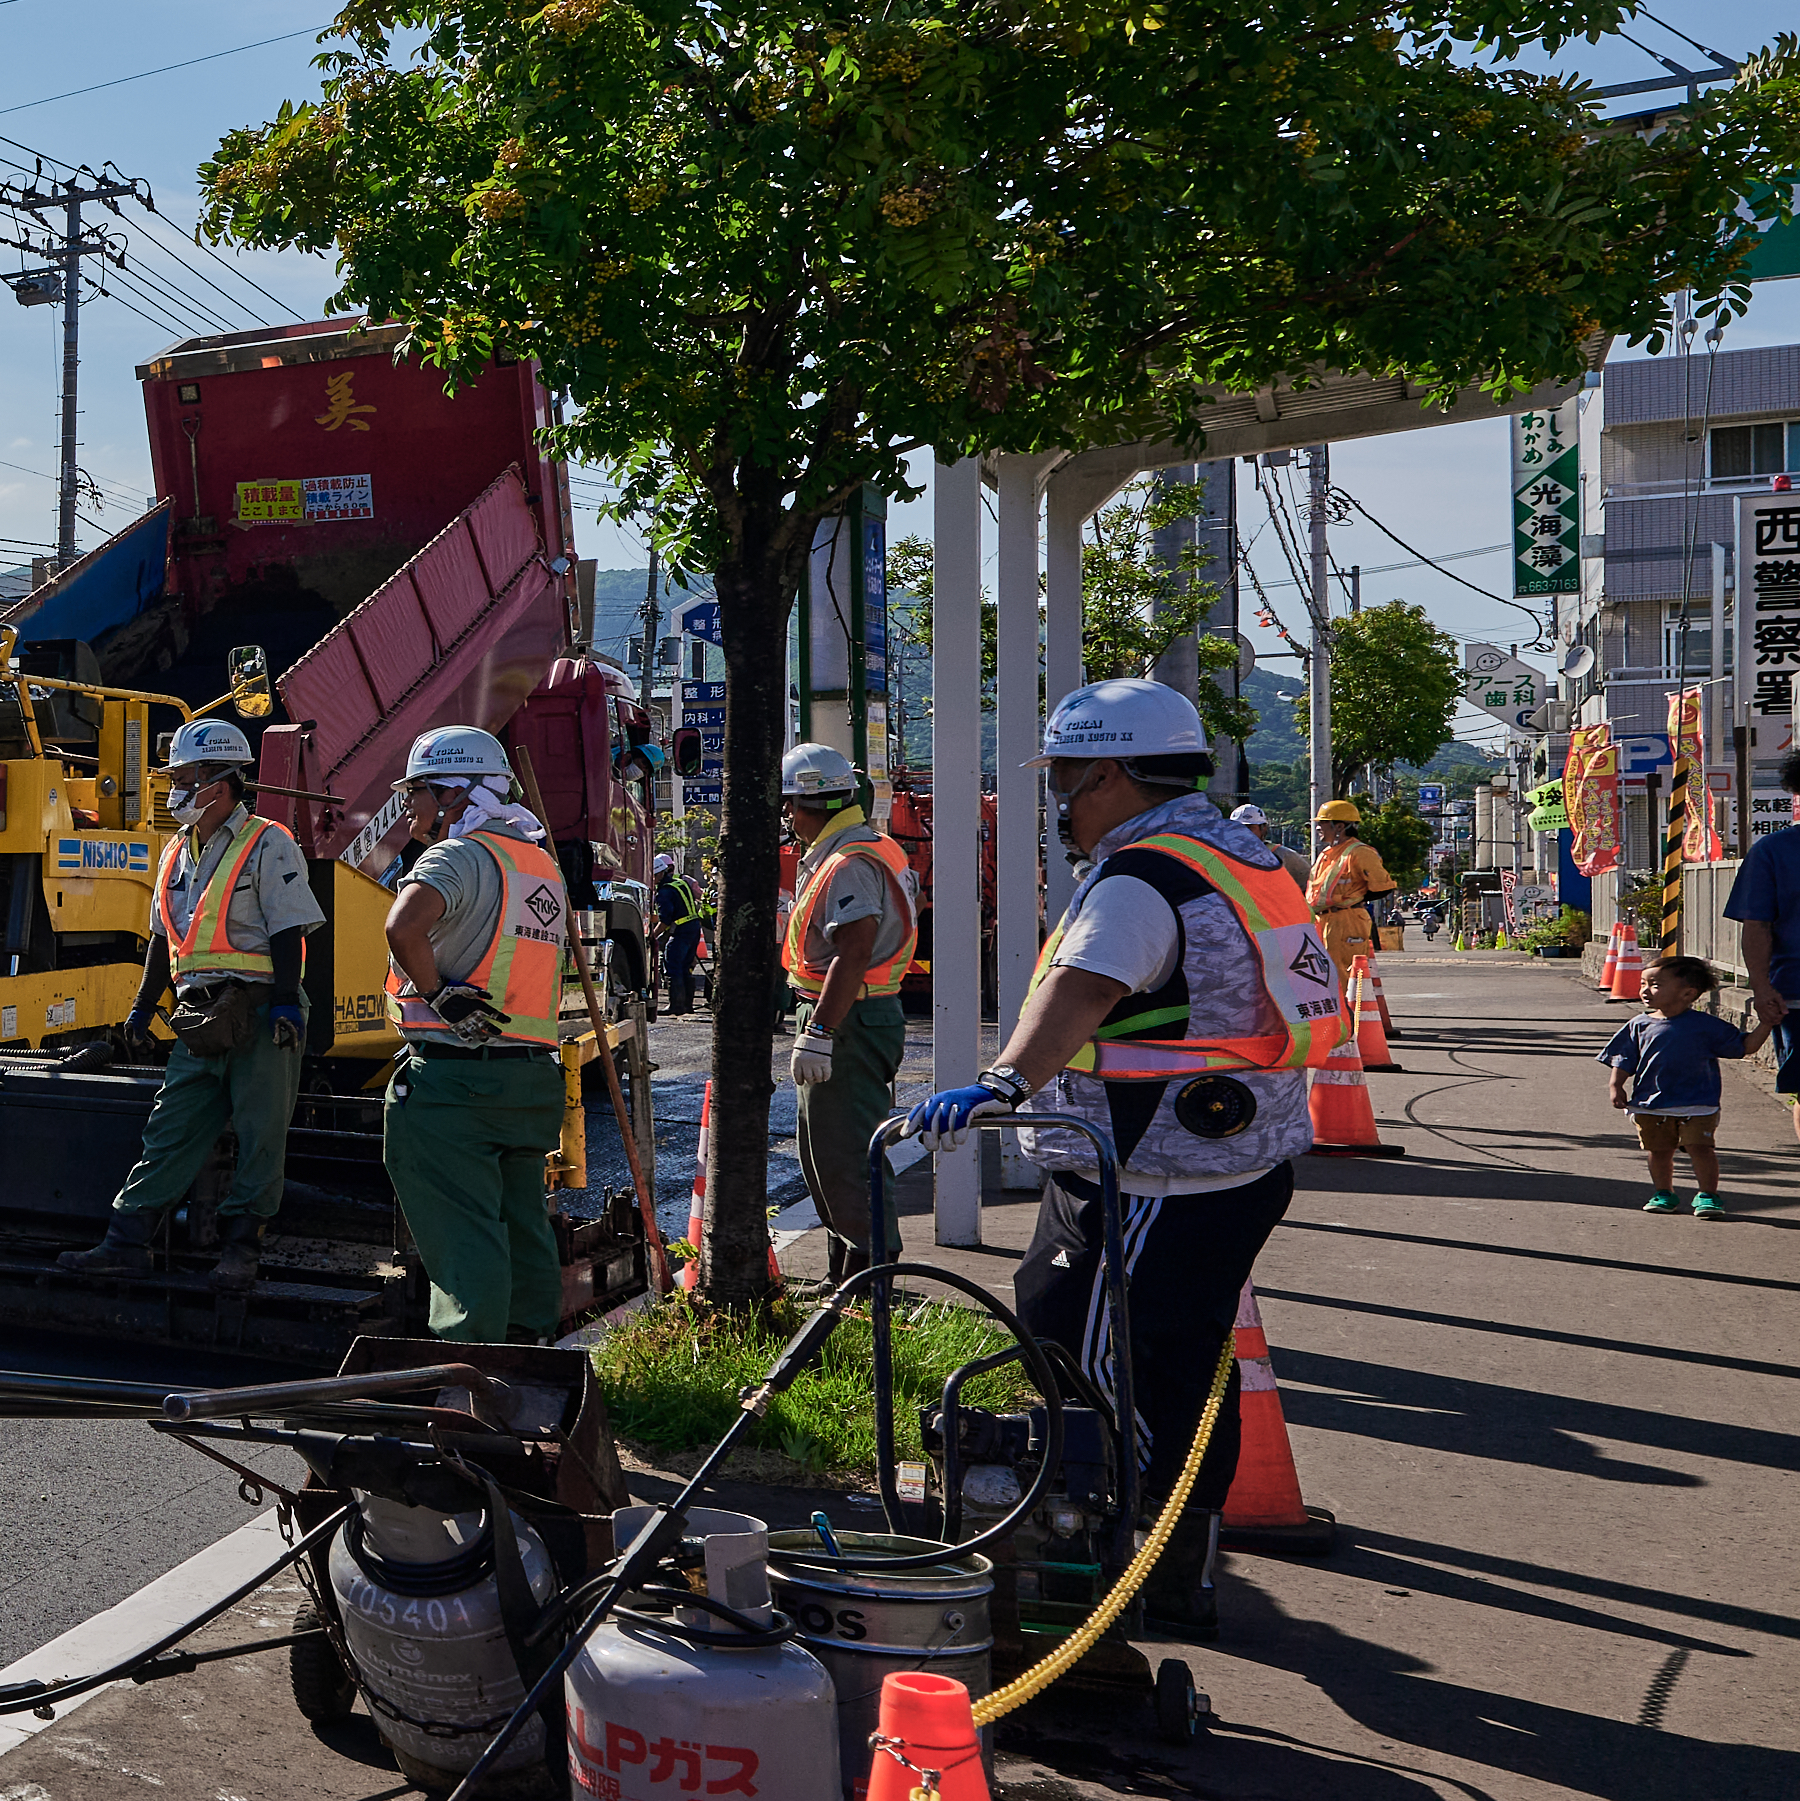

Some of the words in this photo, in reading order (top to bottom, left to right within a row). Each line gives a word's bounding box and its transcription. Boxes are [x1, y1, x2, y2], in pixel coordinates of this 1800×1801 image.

[314, 371, 377, 431] 美
[1520, 411, 1545, 464] わかめ
[305, 476, 368, 492] 過積載防止
[243, 485, 296, 503] 積載量
[306, 489, 369, 505] 積載ライン
[241, 506, 262, 517] ここ
[278, 504, 300, 516] まで
[1530, 483, 1562, 568] 光海藻
[1528, 578, 1578, 592] 663-7163
[1472, 674, 1536, 692] アース
[1484, 689, 1537, 707] 歯科
[1065, 719, 1103, 731] TOKAI
[1622, 737, 1668, 770] P
[83, 841, 128, 870] NISHIO
[534, 897, 554, 916] TKK
[576, 1707, 760, 1798] LPガス
